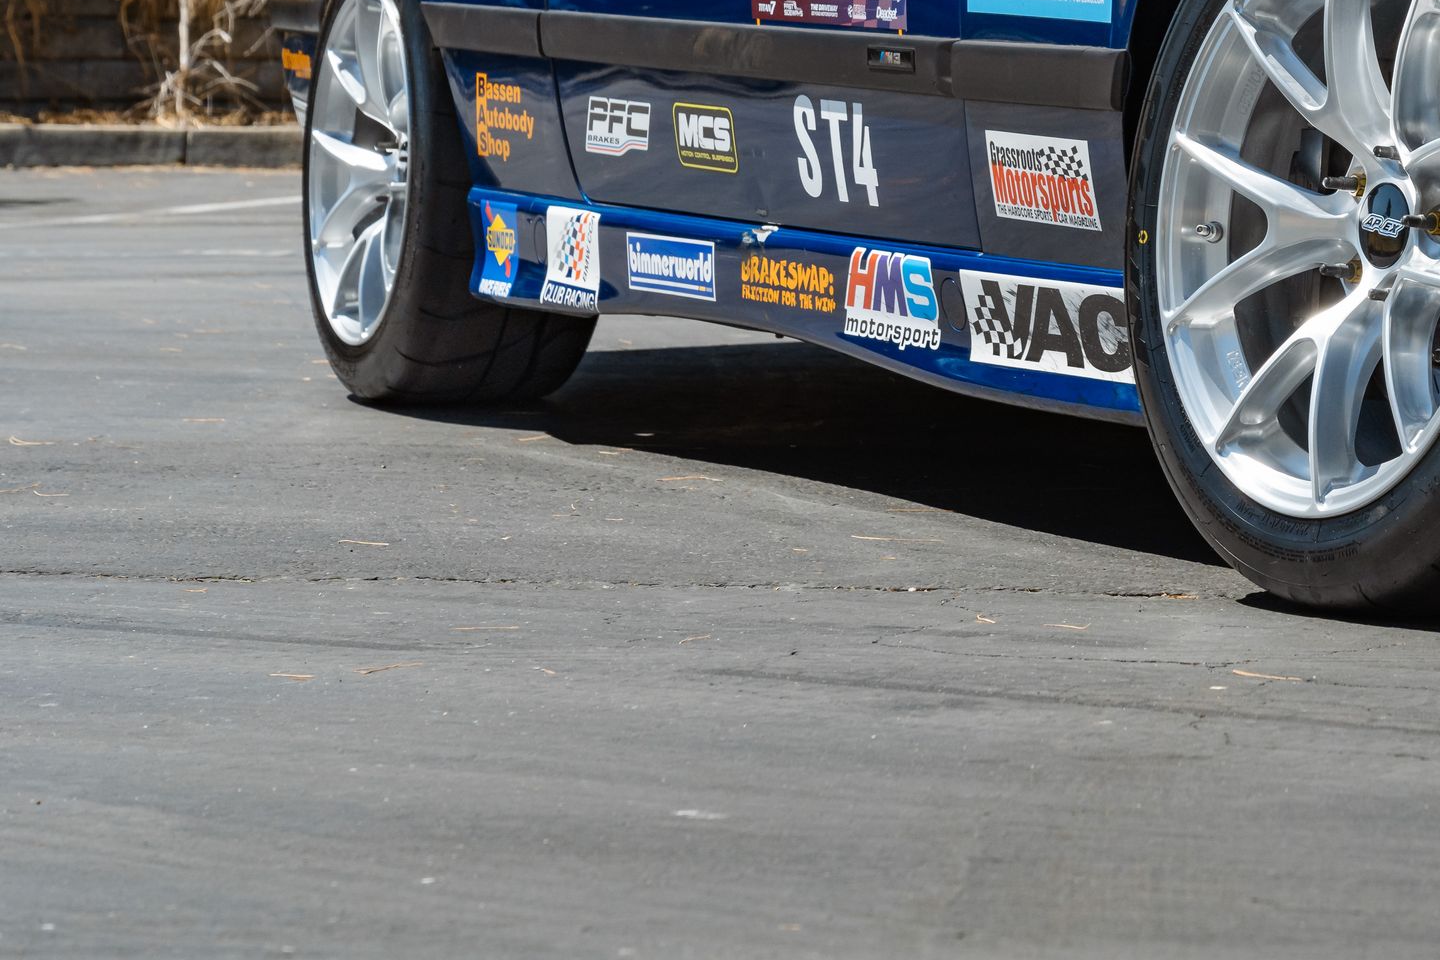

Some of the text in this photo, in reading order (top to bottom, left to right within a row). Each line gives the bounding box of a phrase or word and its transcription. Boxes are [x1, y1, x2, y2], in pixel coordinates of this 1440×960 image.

[478, 76, 521, 103] Bassen
[478, 104, 534, 139] Autobody
[589, 99, 650, 138] PFC
[678, 113, 731, 152] MCS
[480, 131, 510, 162] Shop
[587, 135, 620, 145] BRAKES
[793, 95, 879, 207] ST4
[990, 141, 1042, 172] Grassroots
[992, 160, 1094, 222] Motorsports
[998, 204, 1007, 215] THE
[1007, 205, 1033, 219] HARDCORE
[1034, 208, 1053, 222] SPORTS
[1057, 213, 1070, 224] CAR
[488, 229, 514, 251] SUNOCO
[629, 242, 712, 283] bimmerworld
[544, 283, 595, 310] CLUB RACING
[742, 284, 779, 304] FRICTION
[781, 291, 797, 307] FOR
[799, 293, 813, 310] THE
[847, 250, 938, 321] HMS
[847, 317, 939, 348] motorsport
[981, 279, 1132, 373] VAC
